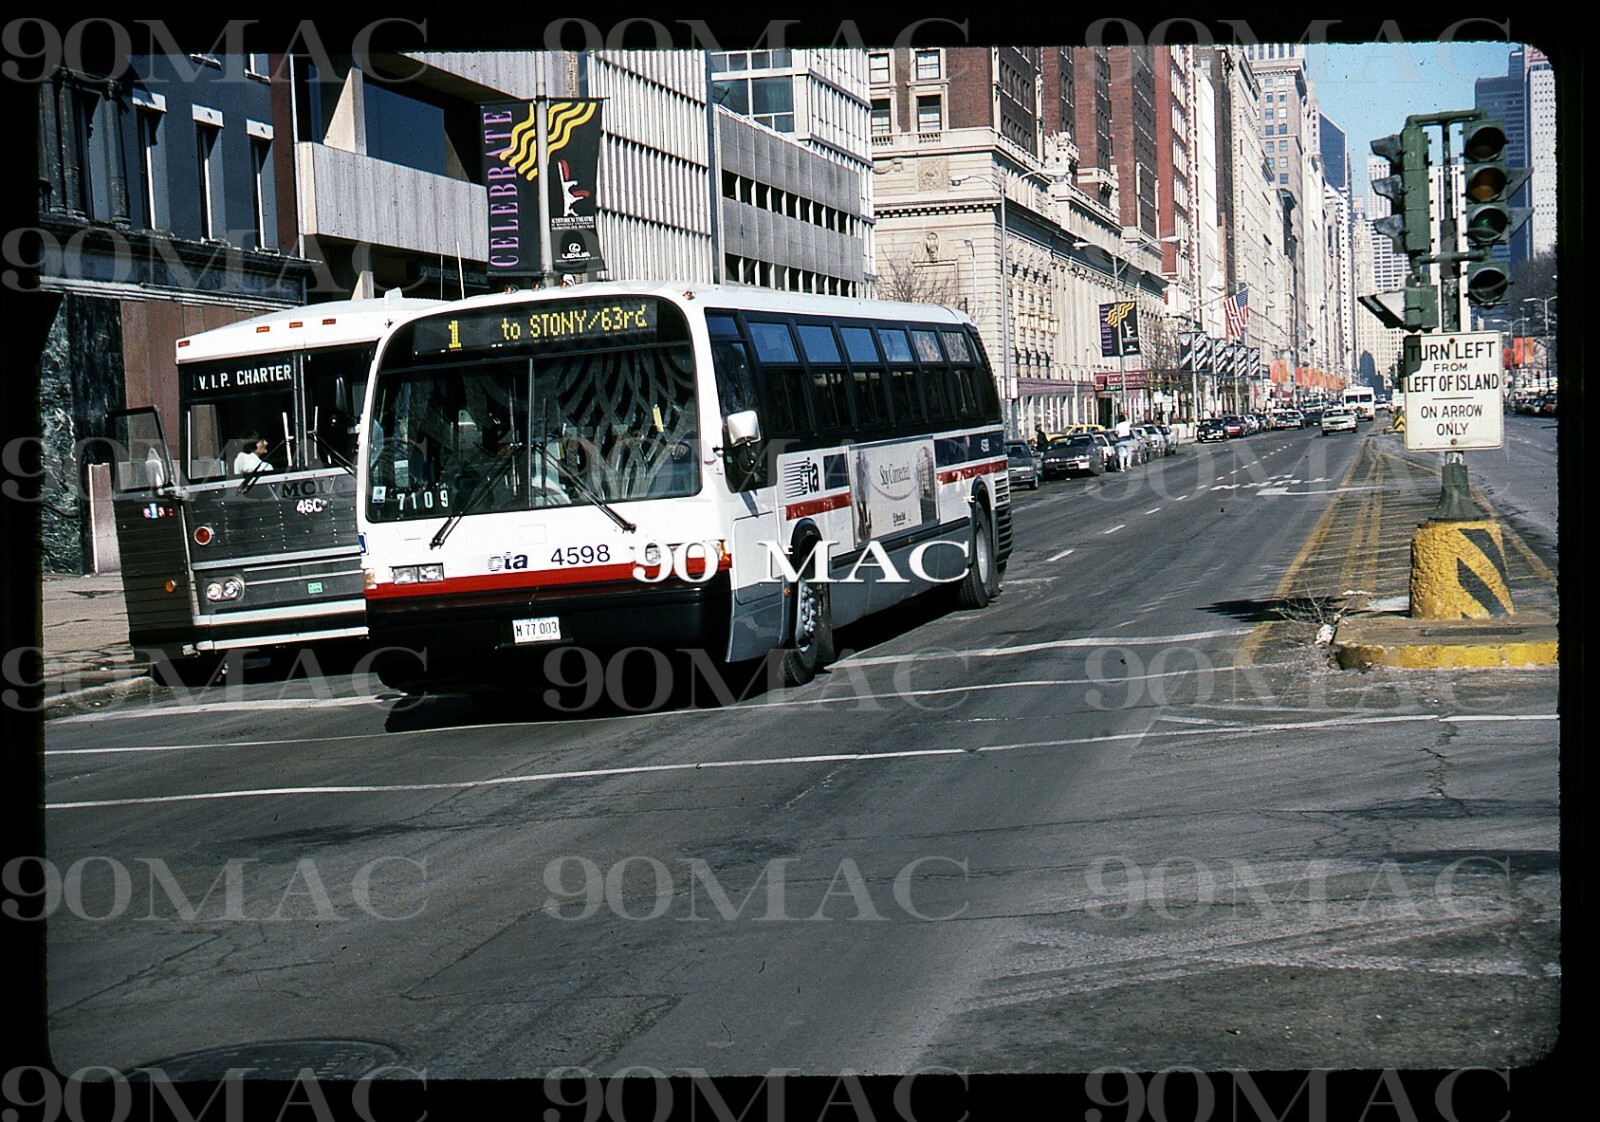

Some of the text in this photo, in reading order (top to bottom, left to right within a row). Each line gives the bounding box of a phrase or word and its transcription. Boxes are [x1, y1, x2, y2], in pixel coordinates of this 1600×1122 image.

[483, 111, 519, 267] CELEBRATE
[448, 304, 648, 349] 1 to STONY/63rd
[1408, 341, 1496, 361] TURN LEFT
[198, 364, 292, 390] V.I.P. CHARTER
[1433, 362, 1468, 373] FROM
[1407, 373, 1499, 393] LEFT OF ISLAND
[1420, 404, 1483, 418] ON ARROW
[1436, 422, 1469, 436] ONLY
[281, 479, 327, 498] MCI
[396, 489, 449, 511] 7109
[487, 544, 611, 572] cta 4598
[525, 623, 536, 636] 77
[539, 621, 558, 635] 003
